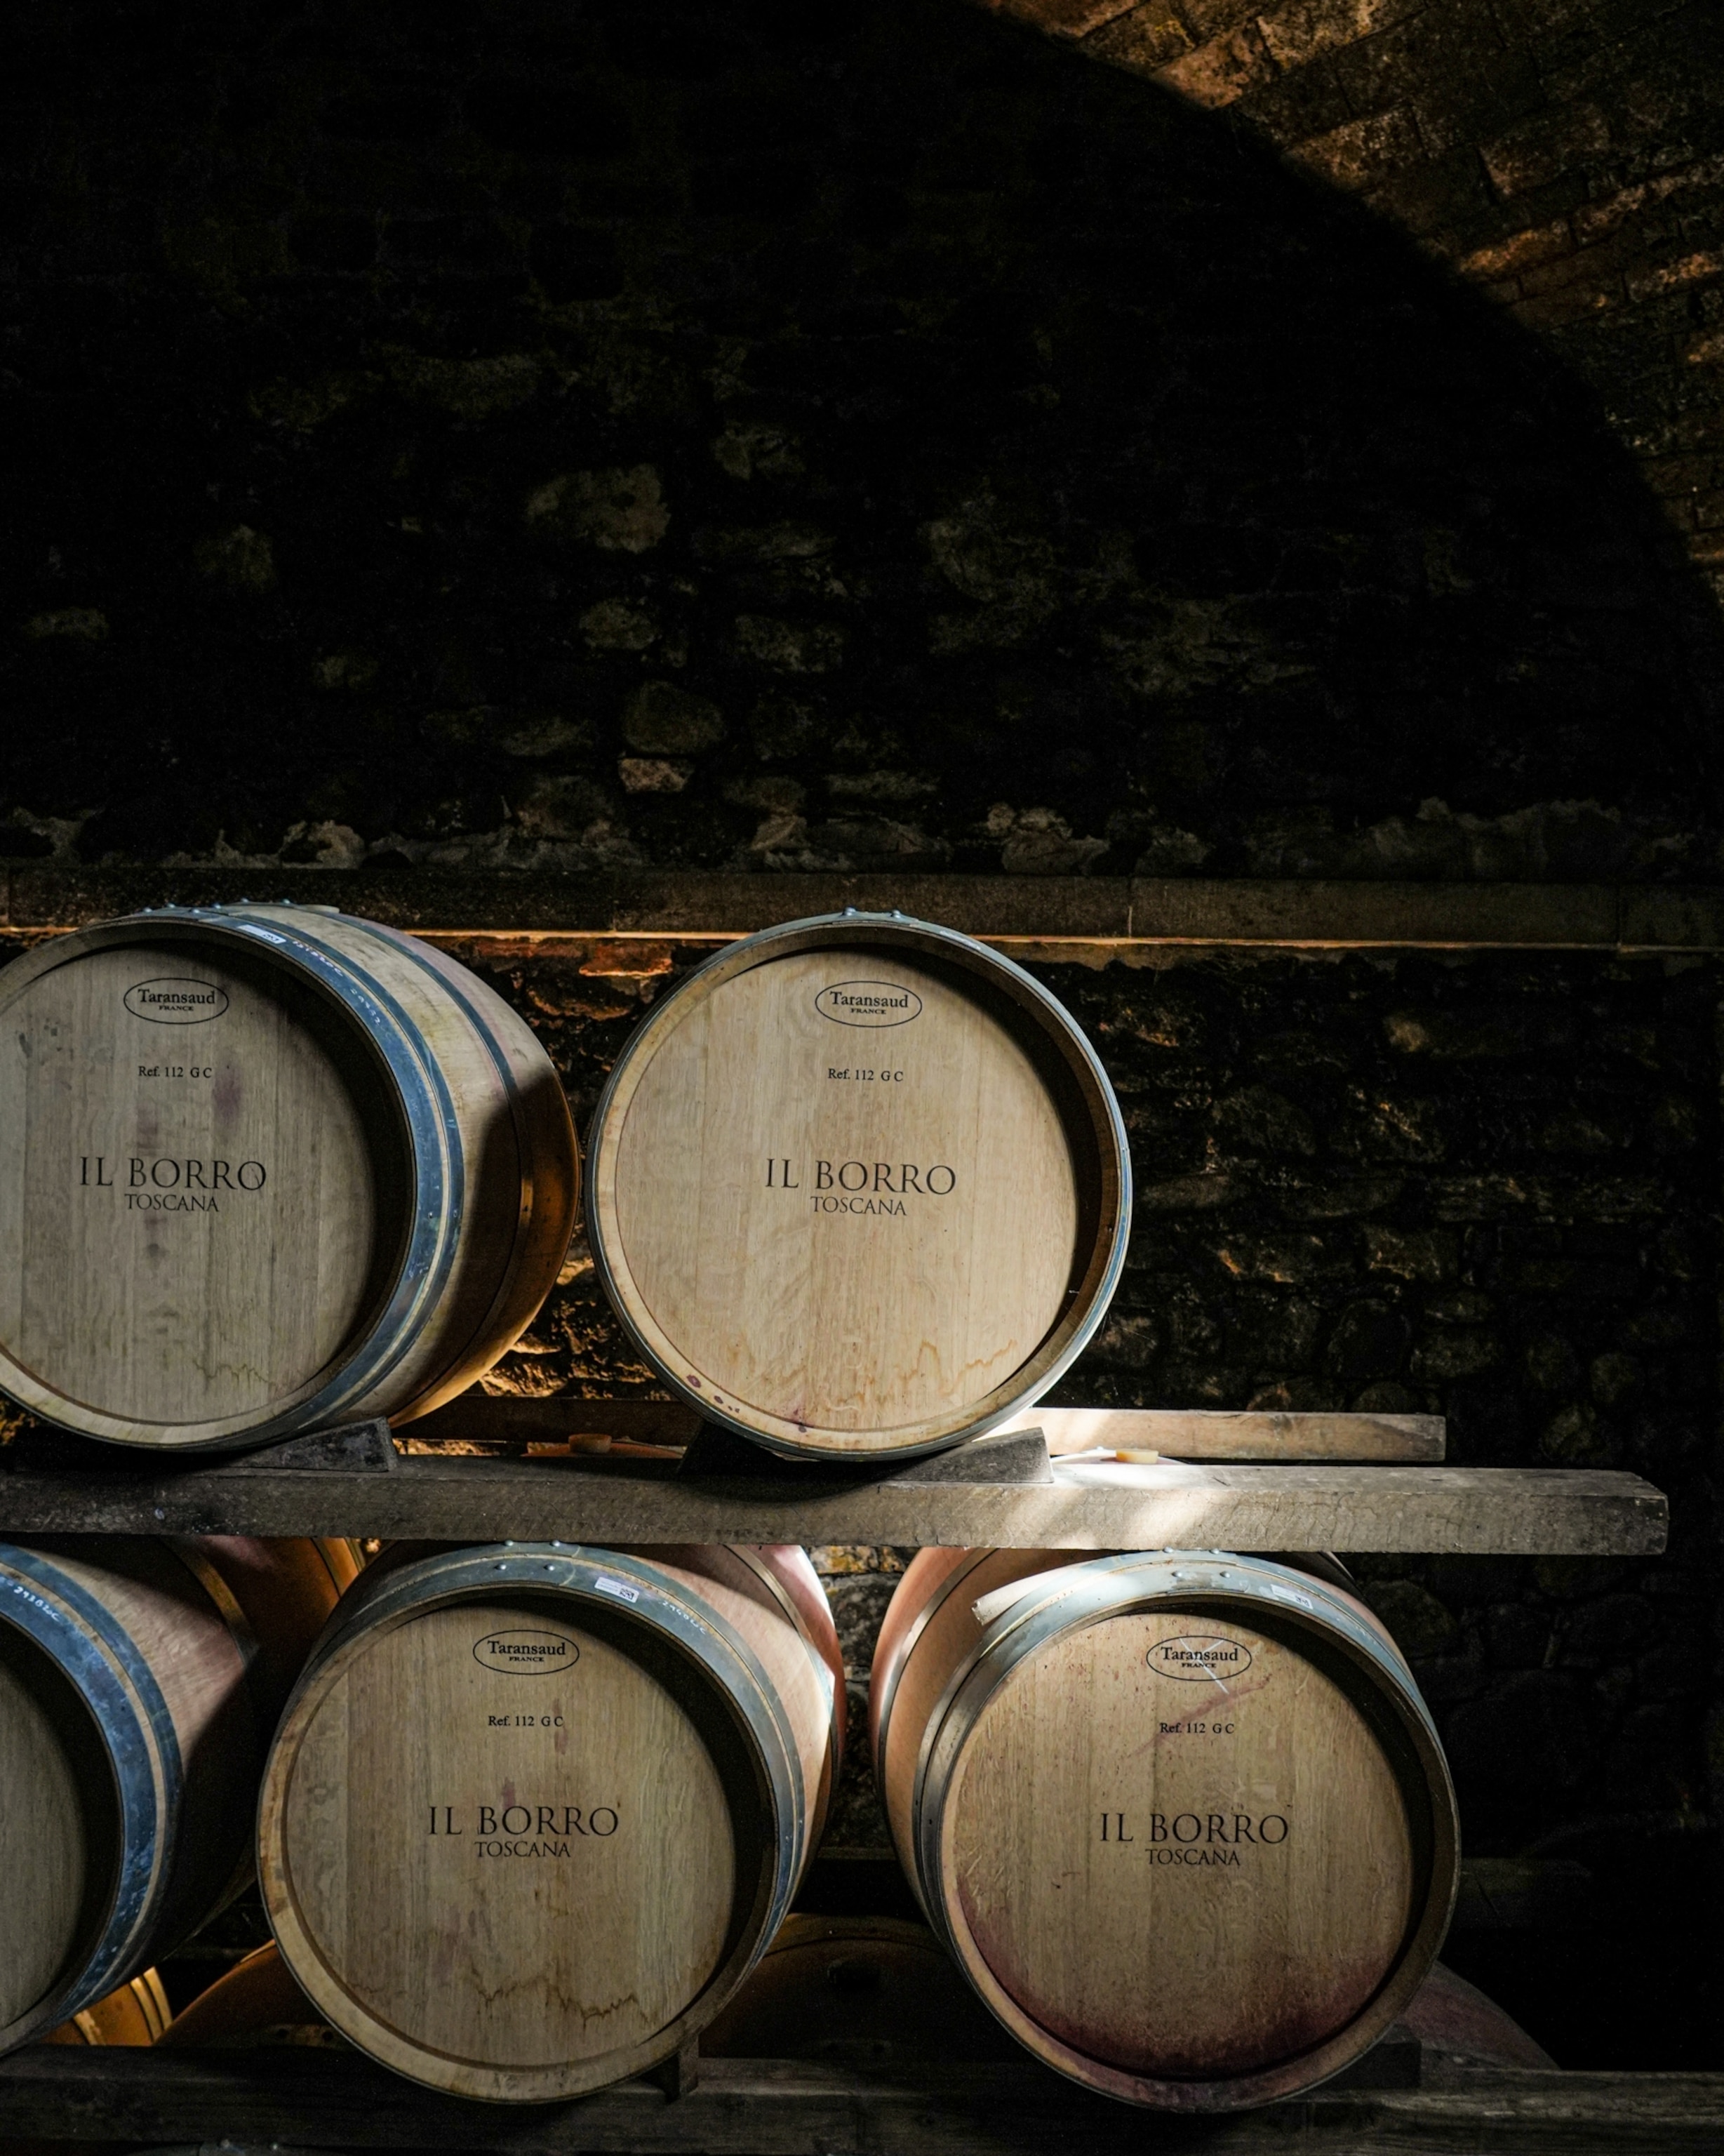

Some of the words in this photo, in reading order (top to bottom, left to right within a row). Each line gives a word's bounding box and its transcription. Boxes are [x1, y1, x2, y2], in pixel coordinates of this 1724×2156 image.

[138, 989, 215, 1004] Taransaud
[829, 991, 909, 1008] Taransaud
[138, 1066, 160, 1077] Ref.
[165, 1067, 184, 1077] 112
[828, 1068, 850, 1079] Ref.
[855, 1070, 874, 1081] 112
[79, 1157, 113, 1186] IL
[128, 1158, 267, 1190] BORRO
[765, 1158, 799, 1188] IL
[815, 1160, 956, 1195] BORRO
[124, 1194, 220, 1212] TOSCANA
[810, 1196, 907, 1216] TOSCANA
[487, 1640, 566, 1656] Taransaud
[1161, 1646, 1238, 1661] Taransaud
[488, 1716, 511, 1726] Ref.
[515, 1716, 535, 1726] 112
[1160, 1723, 1182, 1734] Ref.
[1187, 1723, 1206, 1734] 112
[429, 1806, 462, 1835] IL
[478, 1806, 619, 1837] BORRO
[1100, 1813, 1134, 1842] IL
[1149, 1813, 1289, 1844] BORRO
[474, 1841, 571, 1858] TOSCANA
[1145, 1849, 1241, 1866] TOSCANA
